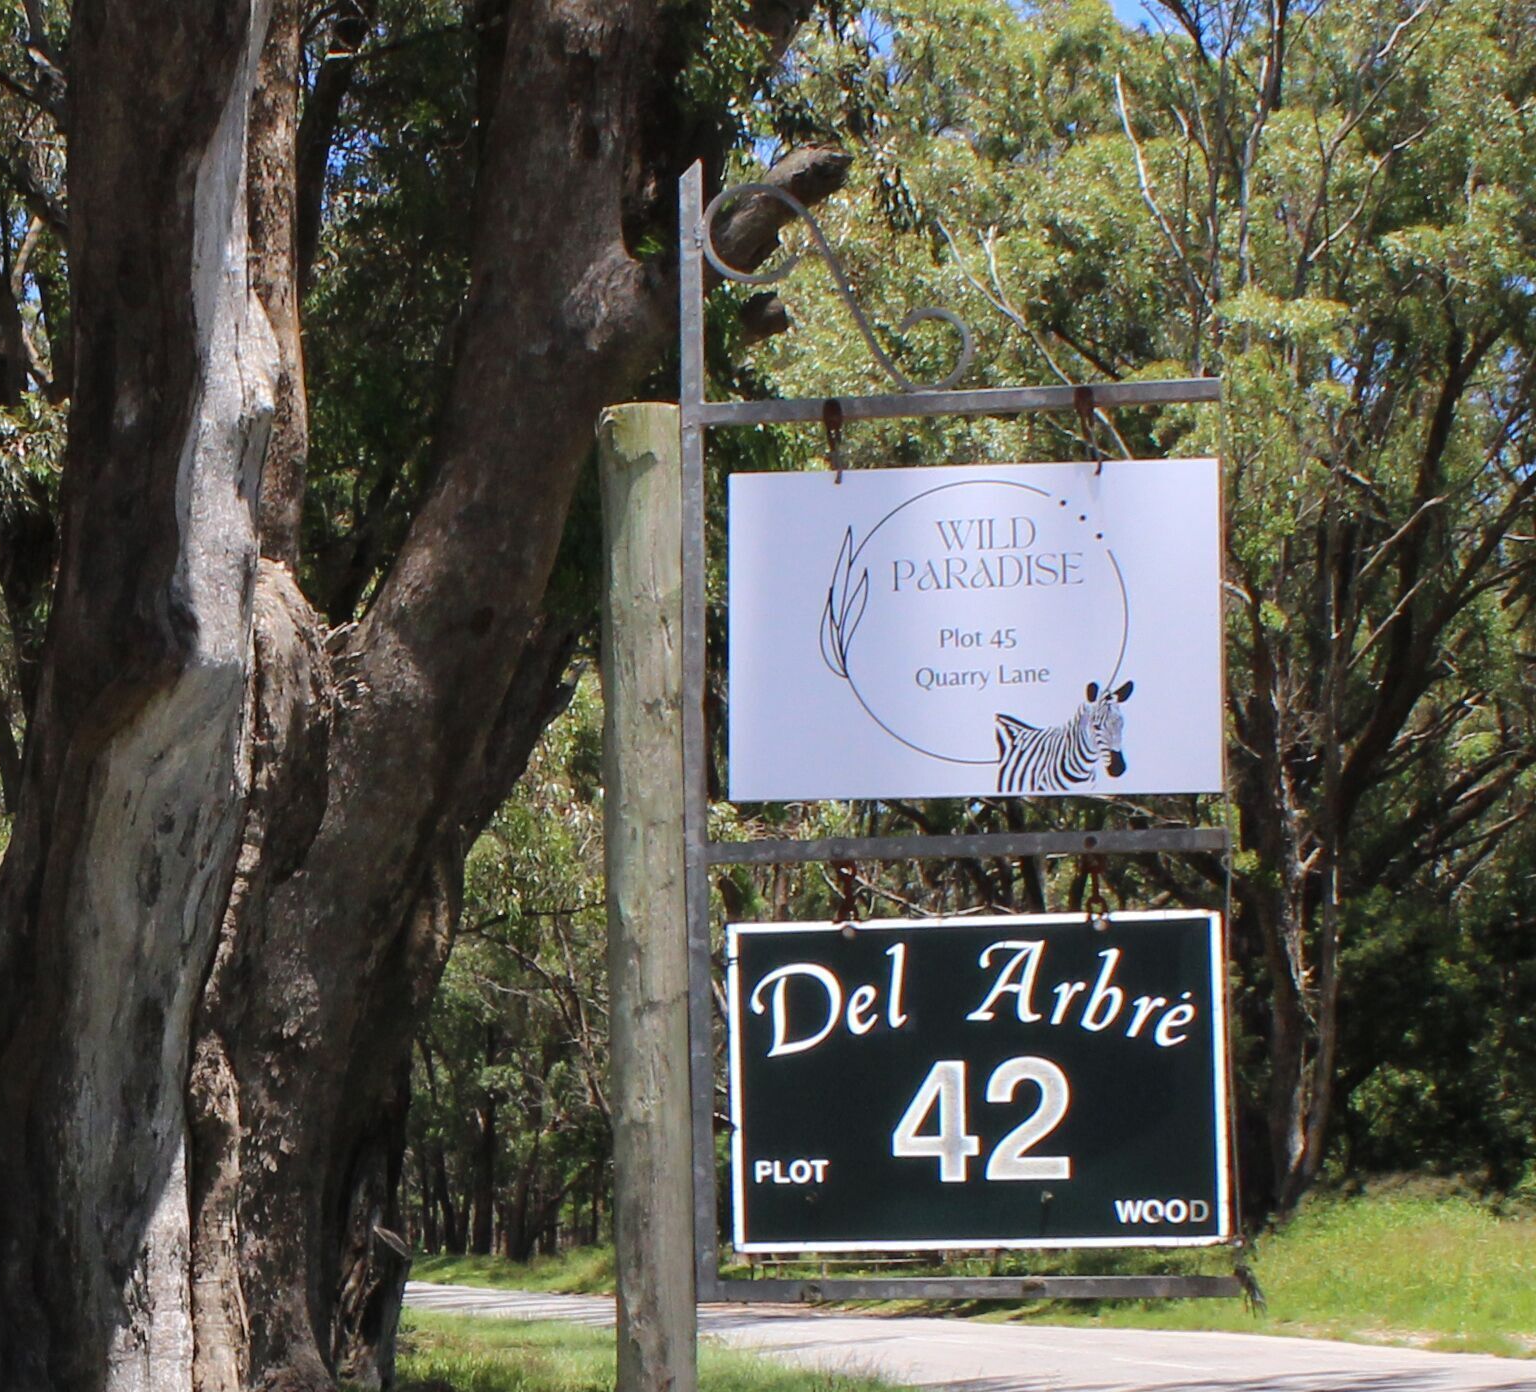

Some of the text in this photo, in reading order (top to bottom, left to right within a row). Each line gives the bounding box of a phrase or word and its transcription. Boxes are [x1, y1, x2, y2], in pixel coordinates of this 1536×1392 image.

[936, 518, 1036, 550] WILD
[893, 553, 1084, 591] PARADISE
[940, 629, 1017, 648] Plot 45
[916, 665, 1050, 690] Quarry Lane
[750, 943, 909, 1058] Del
[892, 1056, 1072, 1183] 42
[754, 1160, 829, 1185] PLOT
[1115, 1200, 1210, 1225] WOOD
